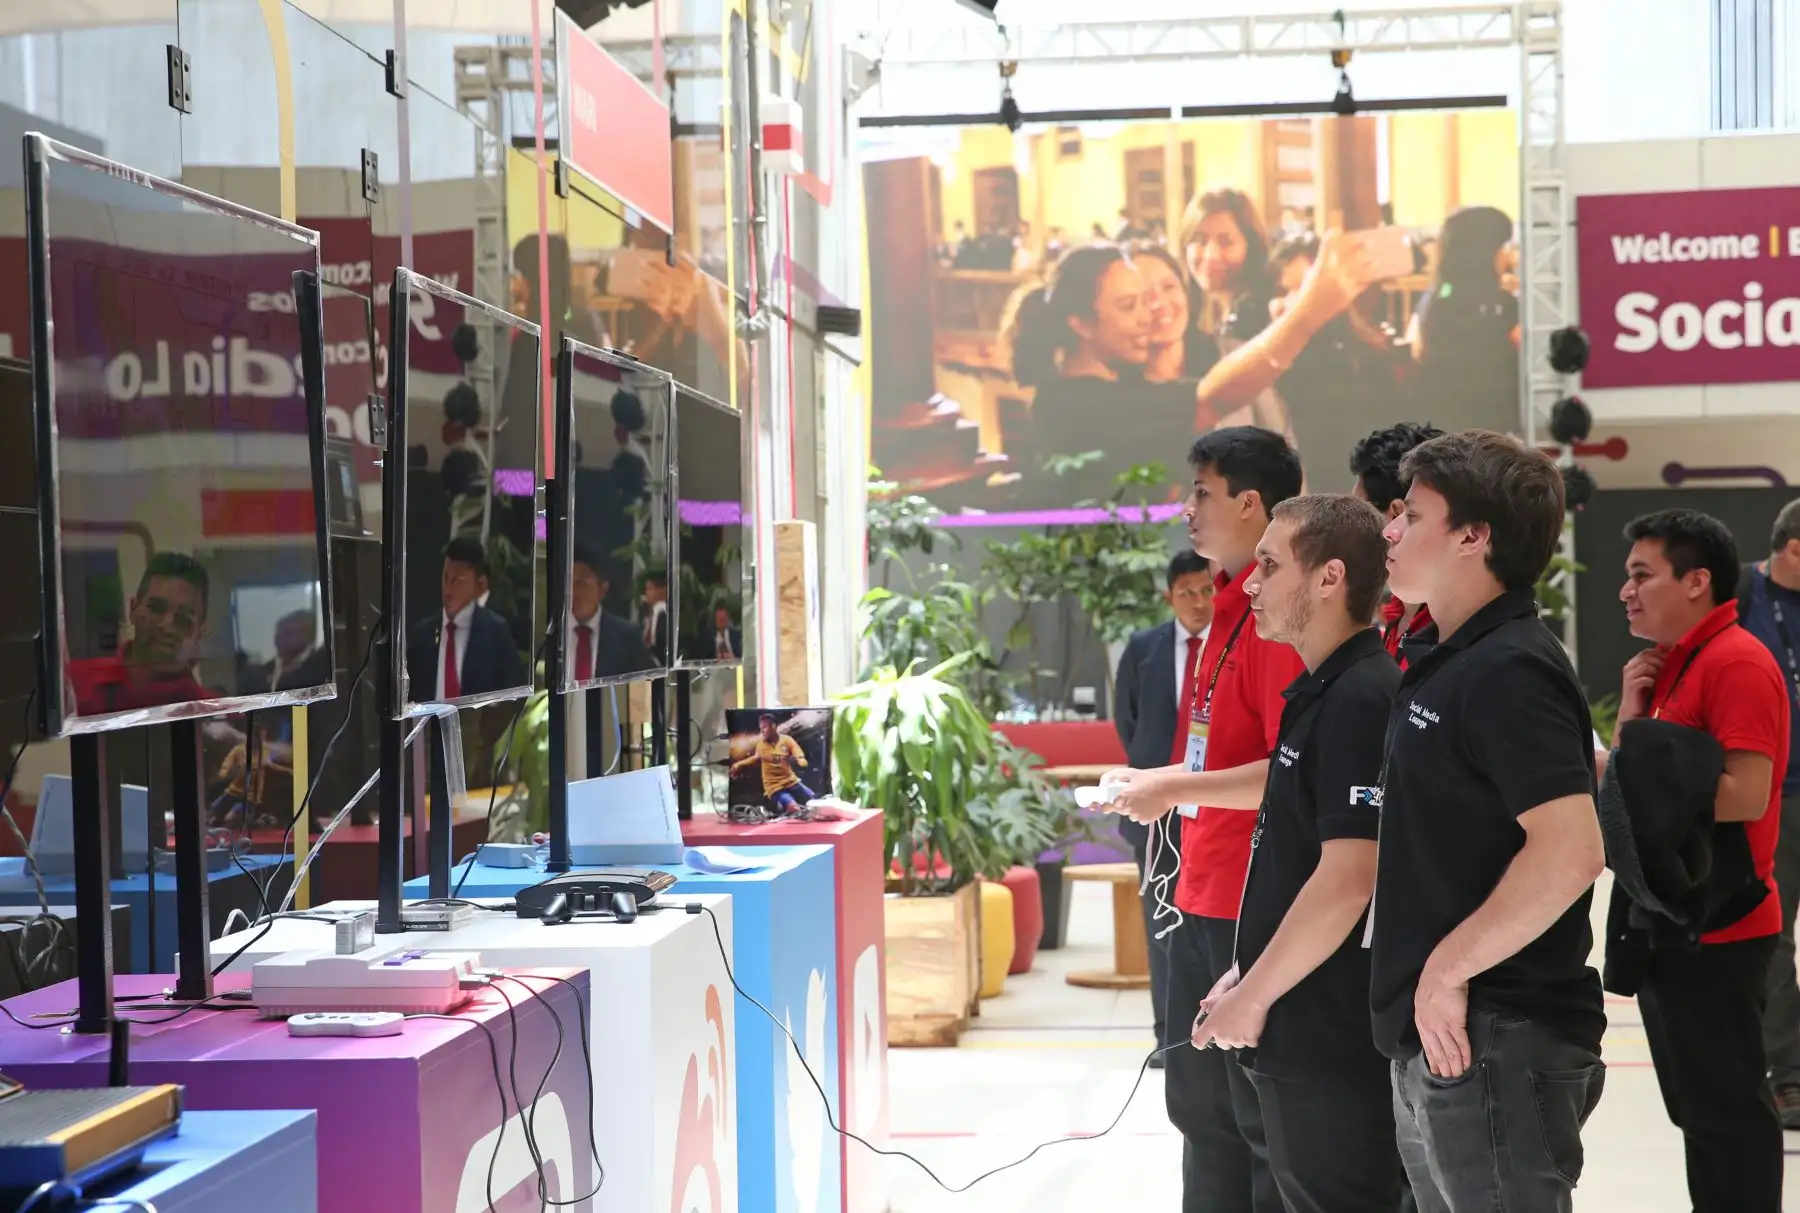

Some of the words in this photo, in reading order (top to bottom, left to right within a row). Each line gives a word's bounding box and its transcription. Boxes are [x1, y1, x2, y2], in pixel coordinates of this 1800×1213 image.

[1610, 232, 1759, 264] Welcome
[1613, 281, 1800, 352] Socia
[1421, 707, 1440, 723] Media
